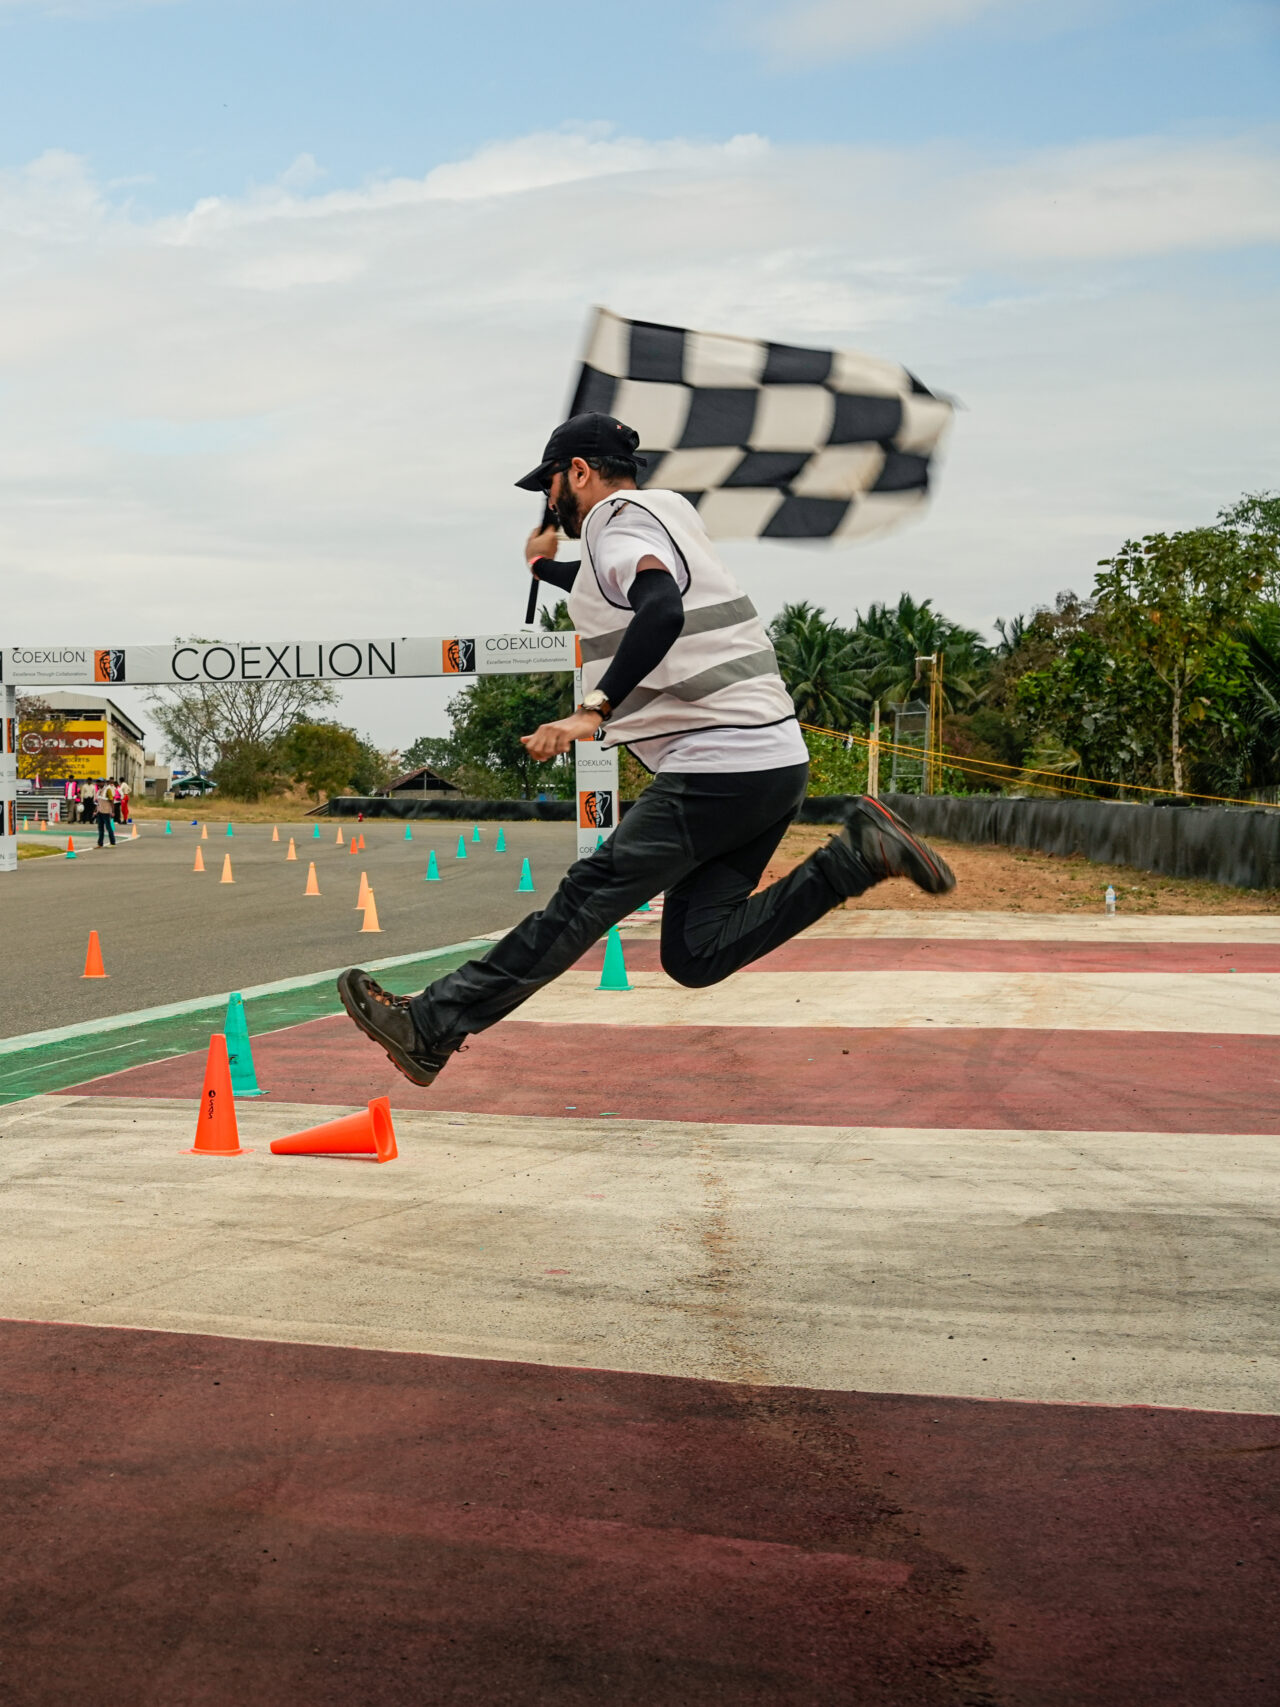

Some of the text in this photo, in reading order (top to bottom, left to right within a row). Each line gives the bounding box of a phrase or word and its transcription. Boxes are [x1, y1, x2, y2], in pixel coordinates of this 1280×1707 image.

[485, 635, 566, 651] COEXLION
[12, 650, 86, 664] COEXLION
[171, 641, 396, 682] COEXLION
[577, 759, 612, 767] COEXLION
